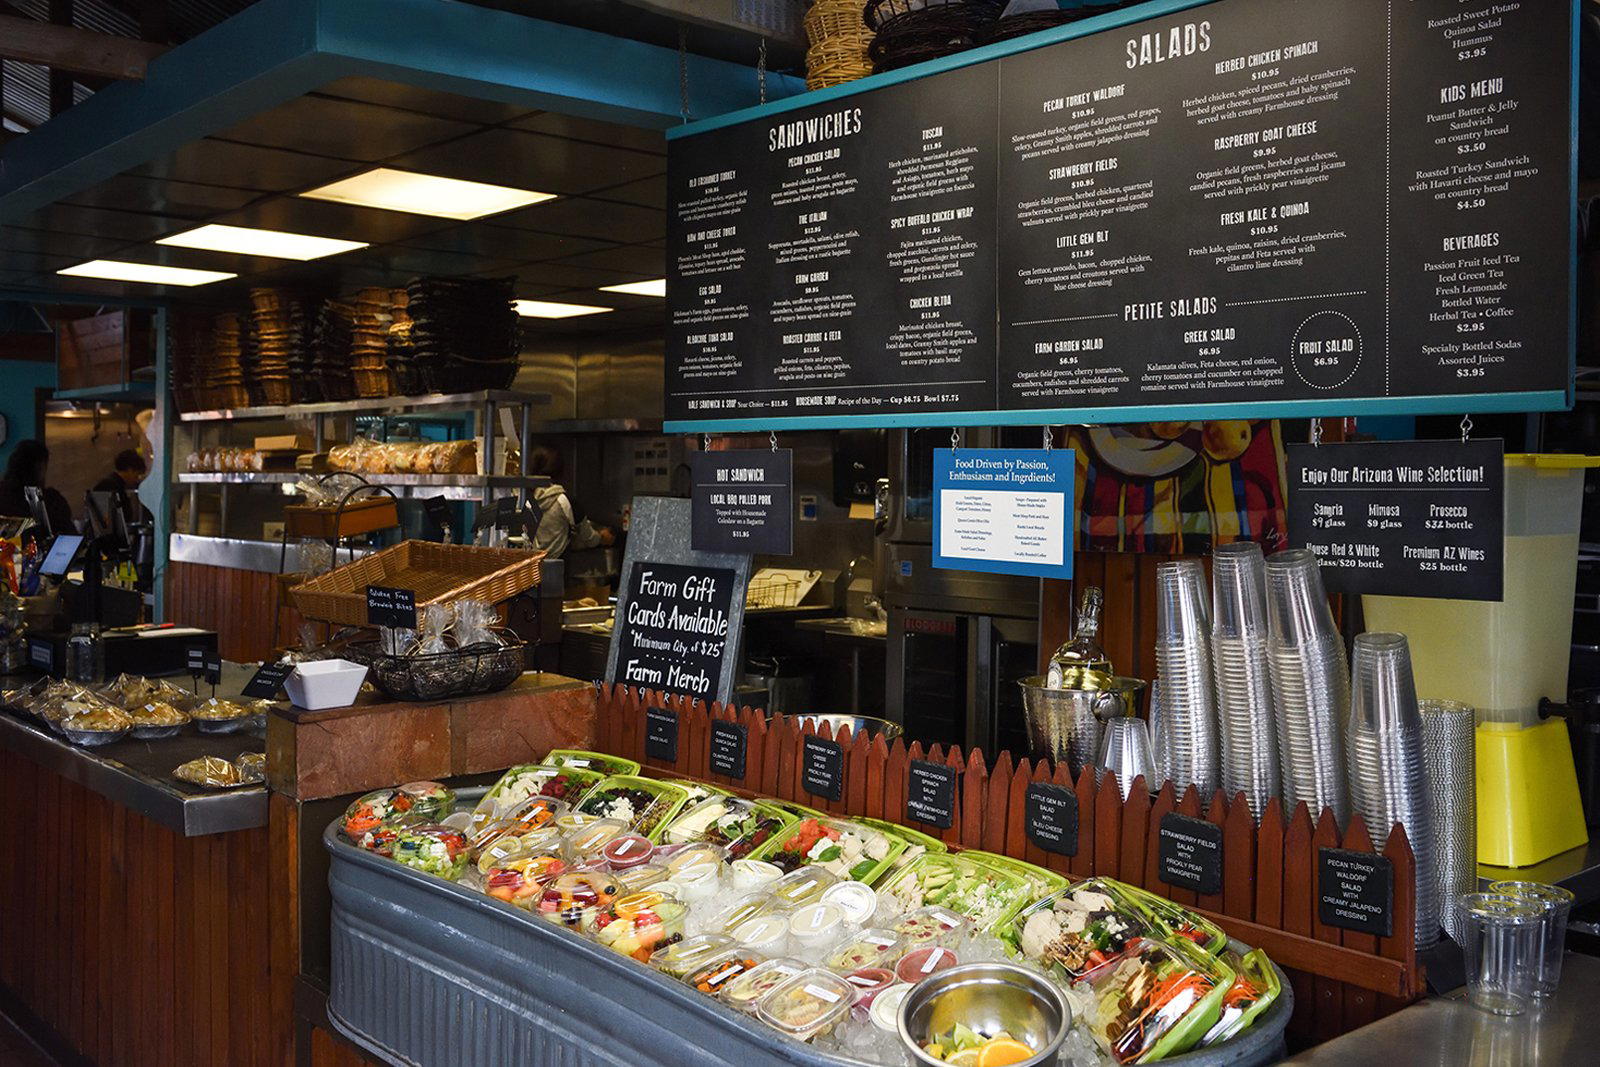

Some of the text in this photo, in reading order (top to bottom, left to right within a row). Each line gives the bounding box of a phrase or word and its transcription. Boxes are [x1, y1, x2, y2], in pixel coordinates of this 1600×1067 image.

[1427, 2, 1520, 29] Roasted Sweet Potato
[1444, 18, 1502, 39] Quinoa Salad
[1126, 21, 1211, 69] SALADS
[1452, 35, 1493, 49] Hummus
[1216, 41, 1318, 75] HERBED CHICKEN SPINACH
[1458, 48, 1486, 61] $3.95
[1251, 68, 1279, 81] $10.95
[1441, 77, 1503, 104] KIDS MENU
[1044, 84, 1125, 112] PECAN TURKEY WALDORF
[1426, 112, 1455, 124] Peanut
[1458, 107, 1485, 117] Butter
[1496, 99, 1519, 113] Jelly
[769, 108, 862, 152] SANDWICHES
[1450, 116, 1493, 131] Sandwich
[1215, 121, 1317, 150] RASPBERRY GOAT CHEESE
[1435, 126, 1509, 145] on country bread
[1253, 147, 1276, 158] $9.95
[1458, 142, 1486, 155] $3.50
[1050, 158, 1118, 181] STRAWBERRY FIELDS
[1416, 155, 1530, 180] Roasted Turkey Sandwich
[1408, 168, 1538, 192] with Havarti cheese and mayo
[1435, 183, 1508, 200] on country bread
[1457, 199, 1485, 210] $4.50
[891, 207, 973, 229] SPICY BUFFALO CHICKEN WRAP
[1221, 202, 1309, 226] FRESH KALE & QUINOA
[1250, 225, 1278, 236] $10.95
[1056, 231, 1109, 248] LITTLE GEM BLT
[1443, 233, 1499, 251] BEVERAGES
[1424, 254, 1520, 272] Passion Fruit Iced Tea
[1439, 269, 1504, 283] Iced Green Tea
[1435, 282, 1508, 296] Fresh Lemonade
[1125, 297, 1217, 321] PETITE SALADS
[1442, 297, 1500, 308] Bottled Water
[1429, 308, 1514, 322] Herbal Tea Coffee
[1457, 323, 1485, 332] $2.95
[1184, 328, 1235, 344] GREEK SALAD
[1035, 339, 1103, 354] FARM GARDEN SALAD
[1199, 348, 1220, 356] $6.95
[1300, 339, 1353, 354] FRUIT SALAD
[1422, 340, 1522, 355] Specialty Bottled Sodas
[1314, 358, 1339, 366] $6.95
[1438, 354, 1505, 365] Assorted Juices
[1457, 368, 1485, 377] $3.95
[955, 459, 1049, 472] Food Driven by Passion,
[717, 469, 764, 481] HOT SANDWICH
[949, 472, 1055, 484] Enthusiasm and Ingrdients!
[1302, 466, 1484, 485] Enjoy Our Arizona Wine Selection!
[710, 495, 771, 505] LOCAL BBQ PULLED PORK
[1314, 504, 1343, 517] Sangria
[1369, 504, 1400, 517] Mimosa
[1430, 504, 1468, 517] Prosecco
[1312, 517, 1346, 528] $9 glass
[1367, 519, 1402, 529] $9 glass
[1425, 520, 1474, 529] $32 bottle
[1306, 543, 1379, 557] House Red & White
[1403, 546, 1484, 561] Premium AZ Wines
[1358, 560, 1384, 569] bottle
[1420, 562, 1468, 572] $25 bottle
[640, 572, 716, 602] Farm Gift
[628, 602, 727, 636] Cards Available
[626, 659, 709, 693] Farm Merch
[1161, 830, 1216, 849] STRAWBERRY FIELDS
[1177, 842, 1194, 852] SALAD
[1166, 857, 1202, 872] PRICKLY PEAR
[1328, 859, 1375, 874] PECAN TURKEY
[1336, 871, 1367, 881] WALDORF
[1341, 882, 1362, 891] SALAD
[1336, 909, 1367, 921] DRESSING
